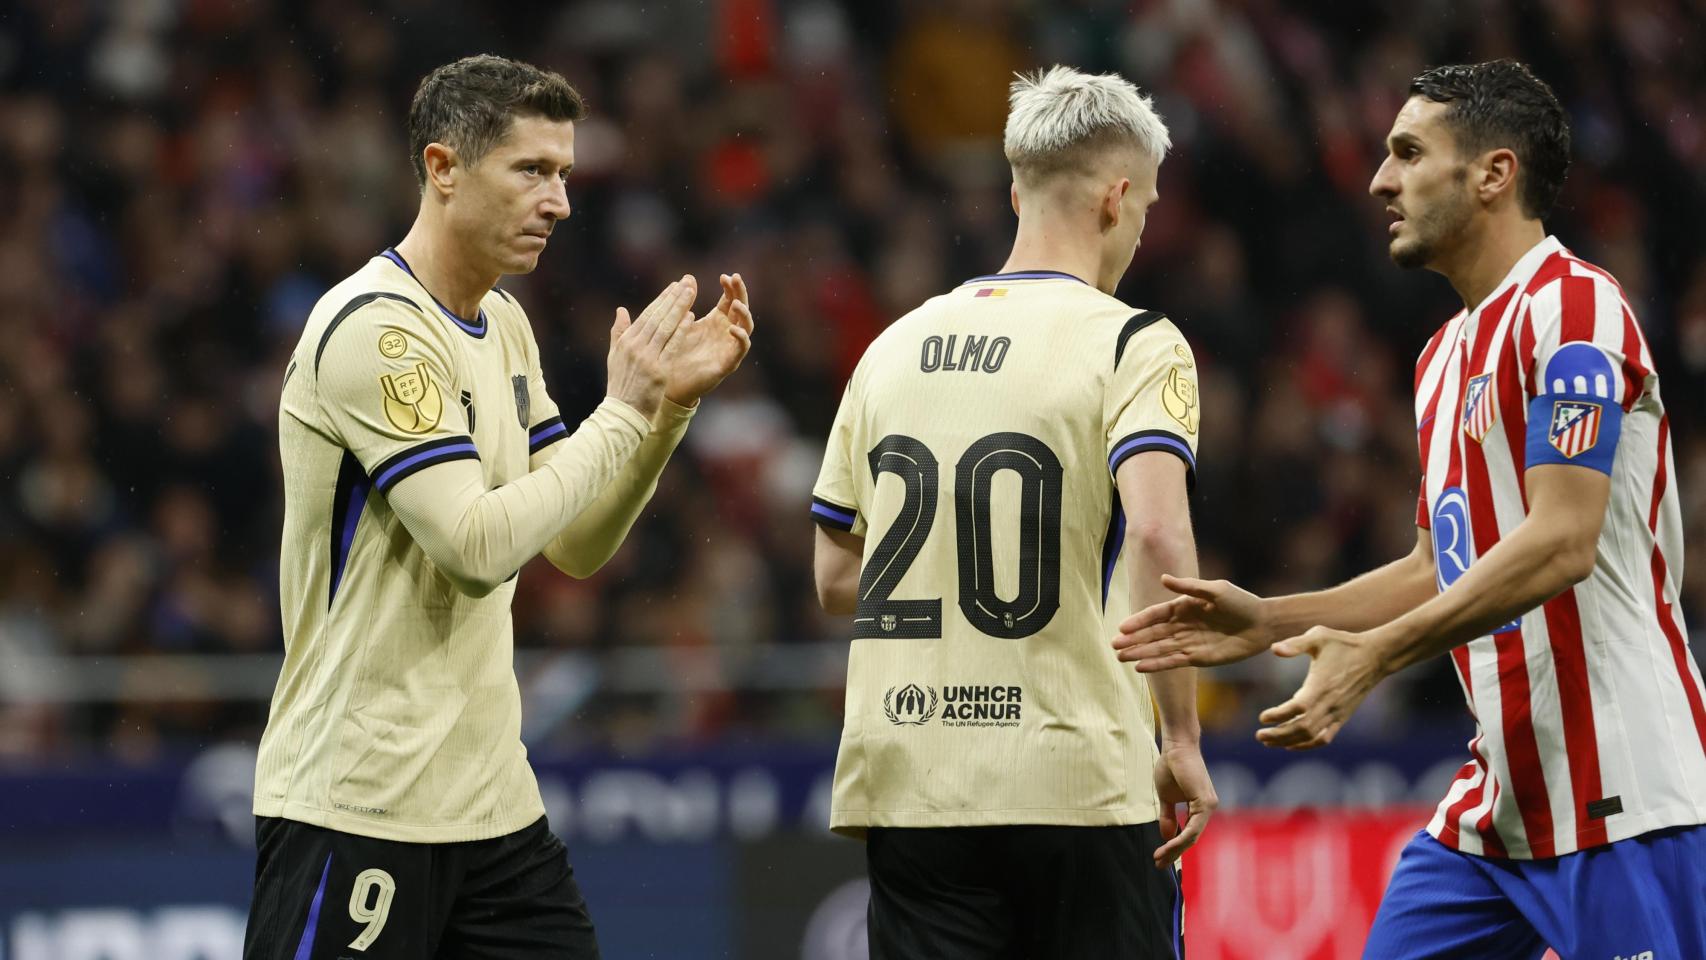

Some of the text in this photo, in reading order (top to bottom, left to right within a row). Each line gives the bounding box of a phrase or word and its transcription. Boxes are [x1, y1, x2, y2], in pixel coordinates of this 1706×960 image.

[384, 338, 402, 351] 32
[920, 334, 1011, 374] OLMO
[853, 432, 1064, 639] 20
[943, 686, 1022, 703] UNHCR
[941, 703, 1021, 720] ACNUR
[347, 868, 396, 952] 9
